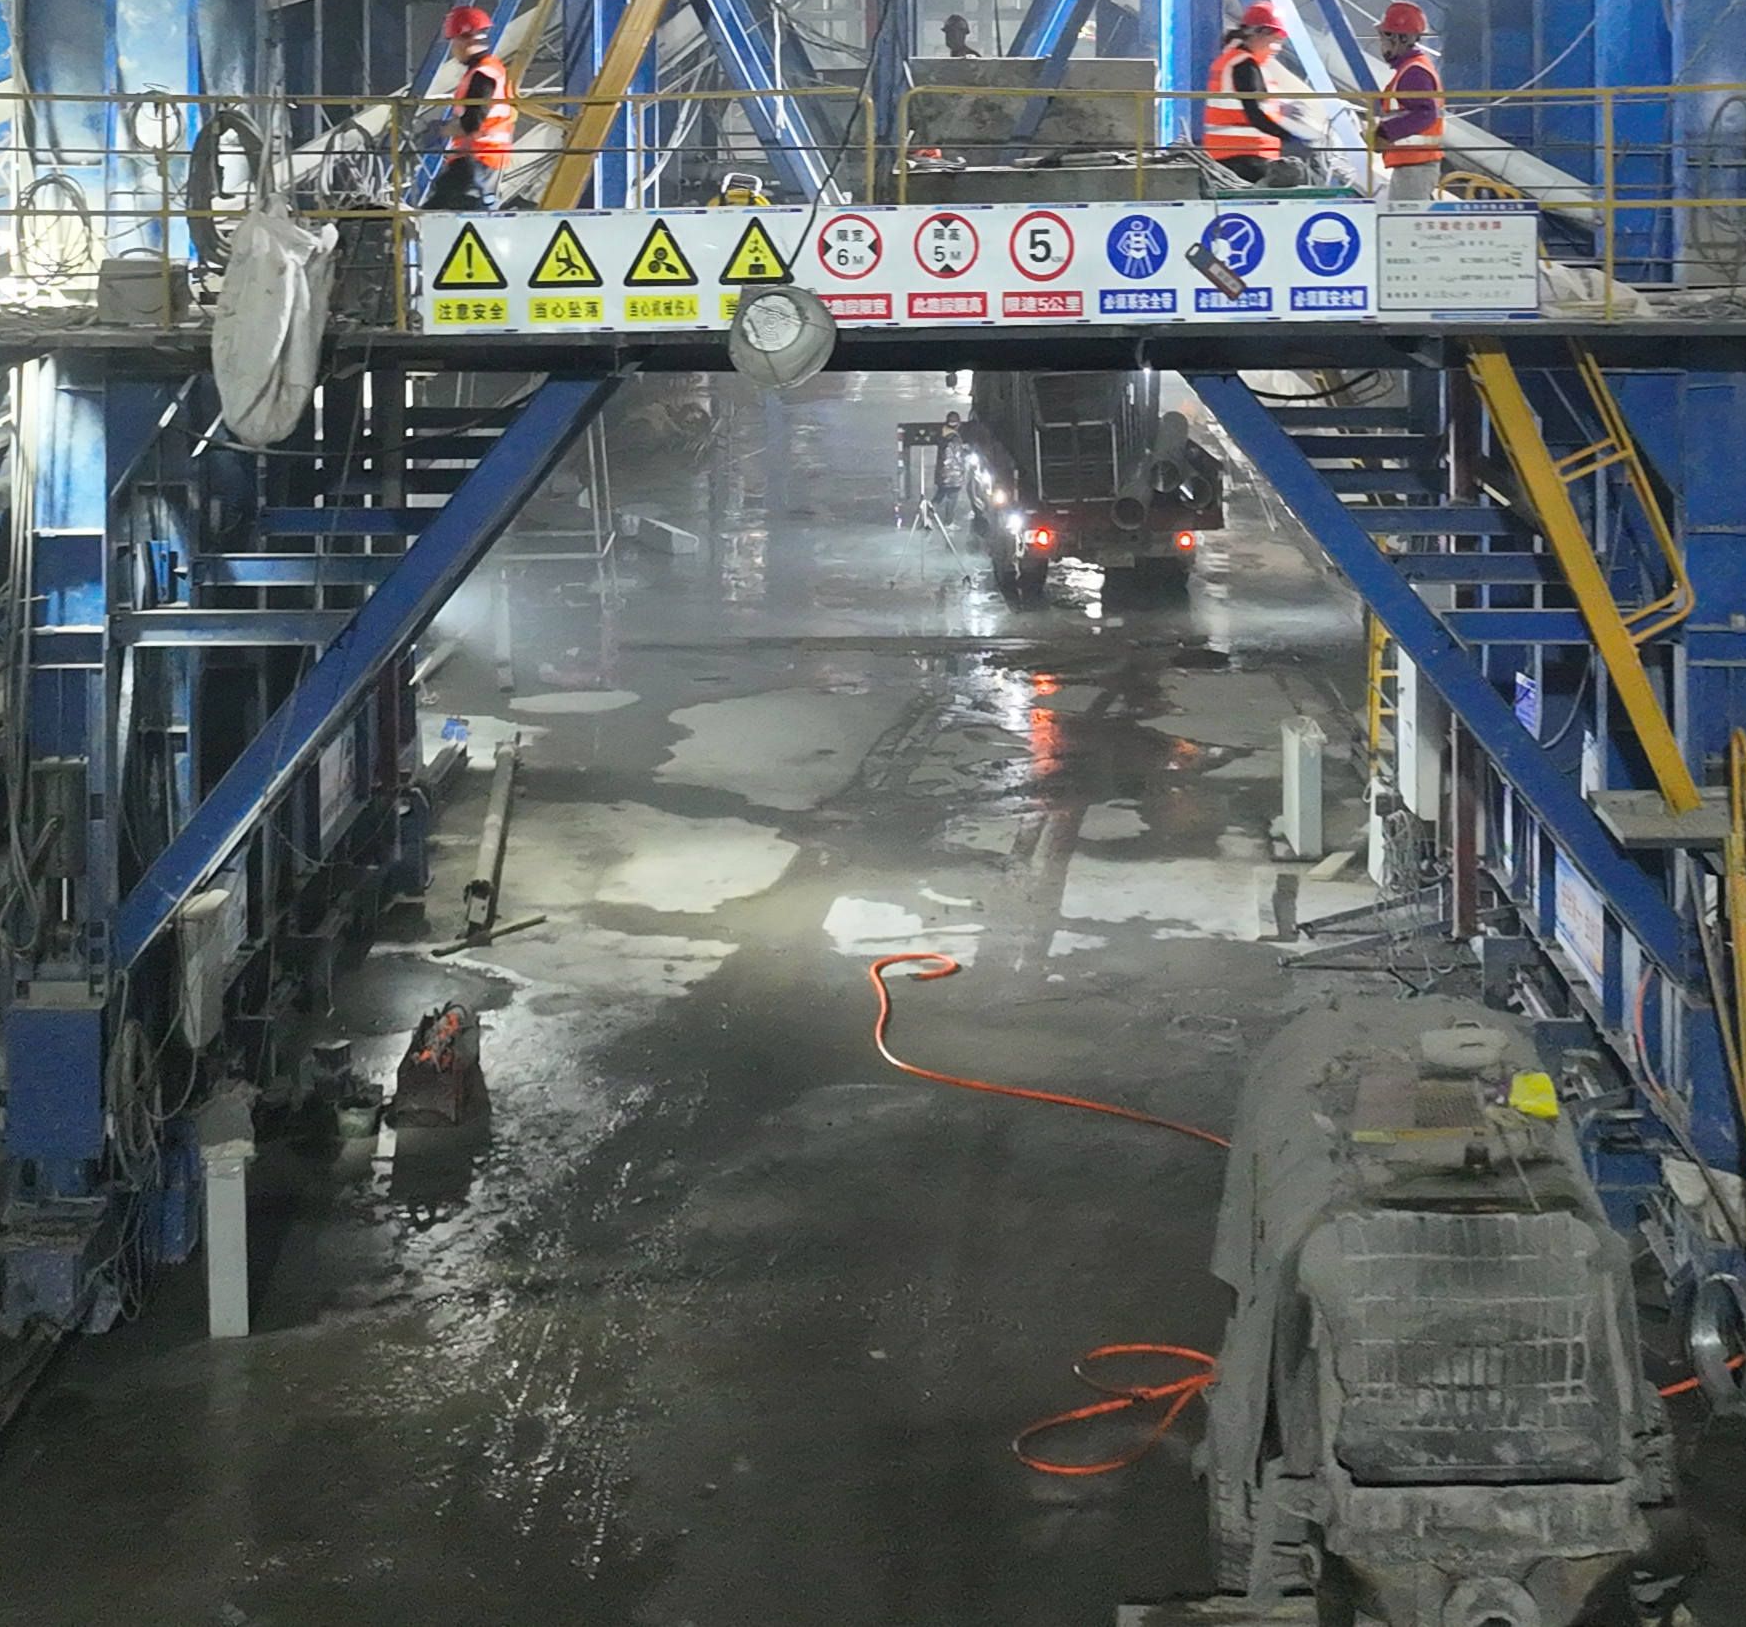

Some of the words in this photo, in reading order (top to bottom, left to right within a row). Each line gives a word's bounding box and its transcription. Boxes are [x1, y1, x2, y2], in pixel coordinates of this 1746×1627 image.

[934, 245, 946, 262] 5
[1029, 228, 1052, 263] 5
[837, 248, 849, 266] 6
[438, 303, 503, 320] 注意安全
[534, 301, 599, 319] 当心坠落
[1003, 295, 1082, 313] 限速5公里
